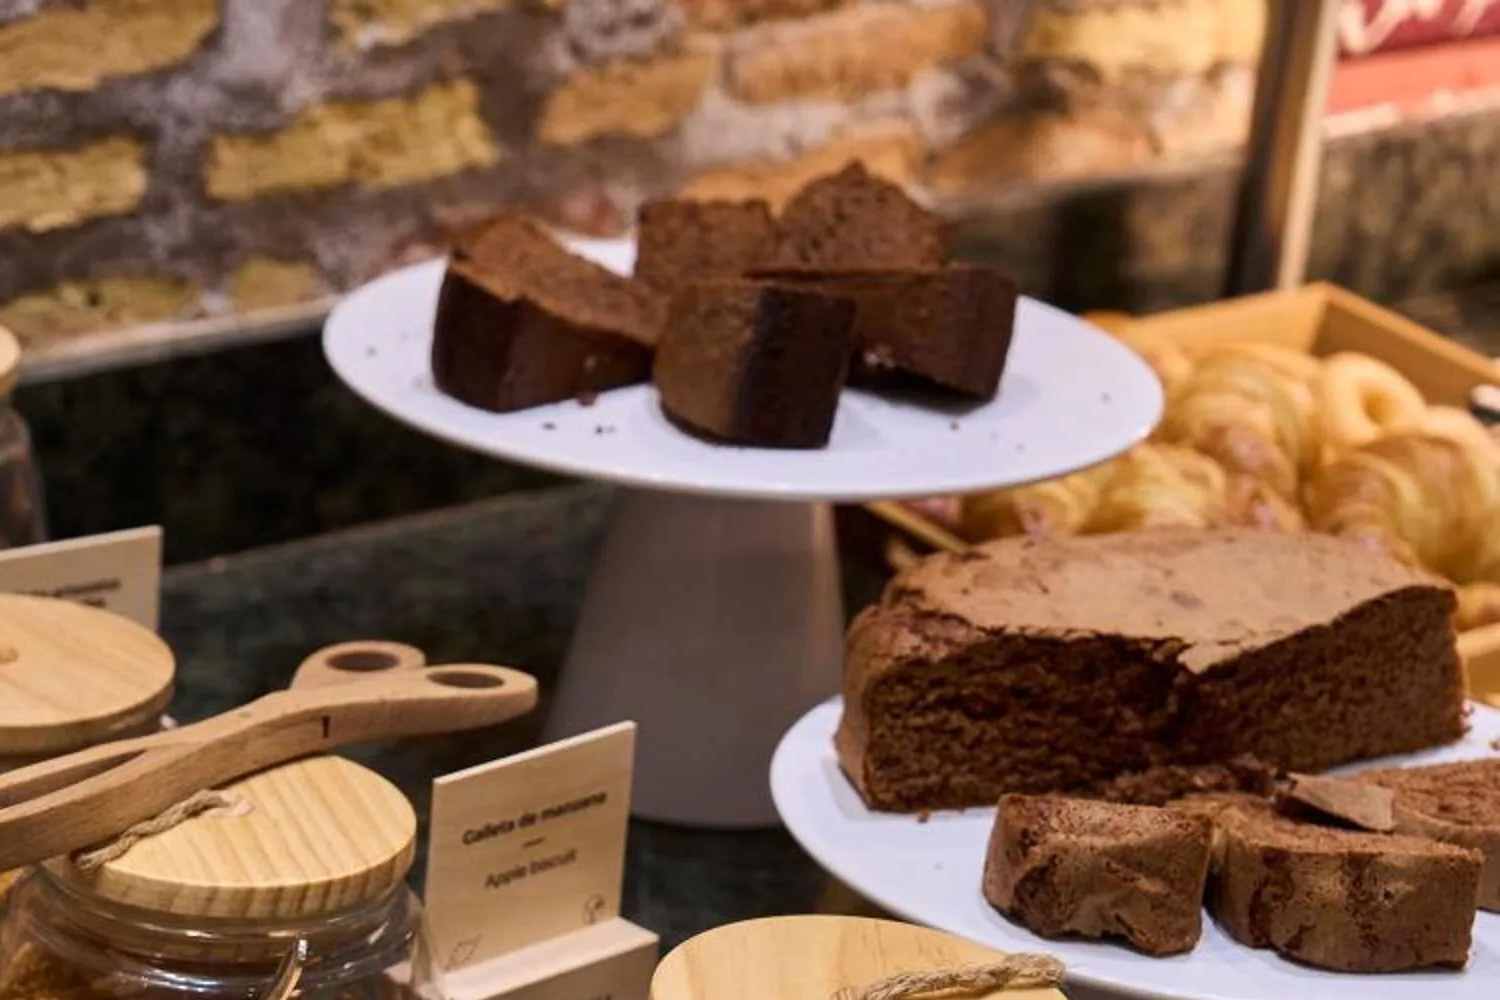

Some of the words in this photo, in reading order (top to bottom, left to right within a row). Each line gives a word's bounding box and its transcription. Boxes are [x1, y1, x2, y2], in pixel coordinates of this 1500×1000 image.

[461, 819, 515, 847] Galleta
[518, 811, 538, 829] de
[541, 791, 608, 822] manzana
[485, 863, 529, 890] Apple
[530, 848, 577, 877] biscuit
